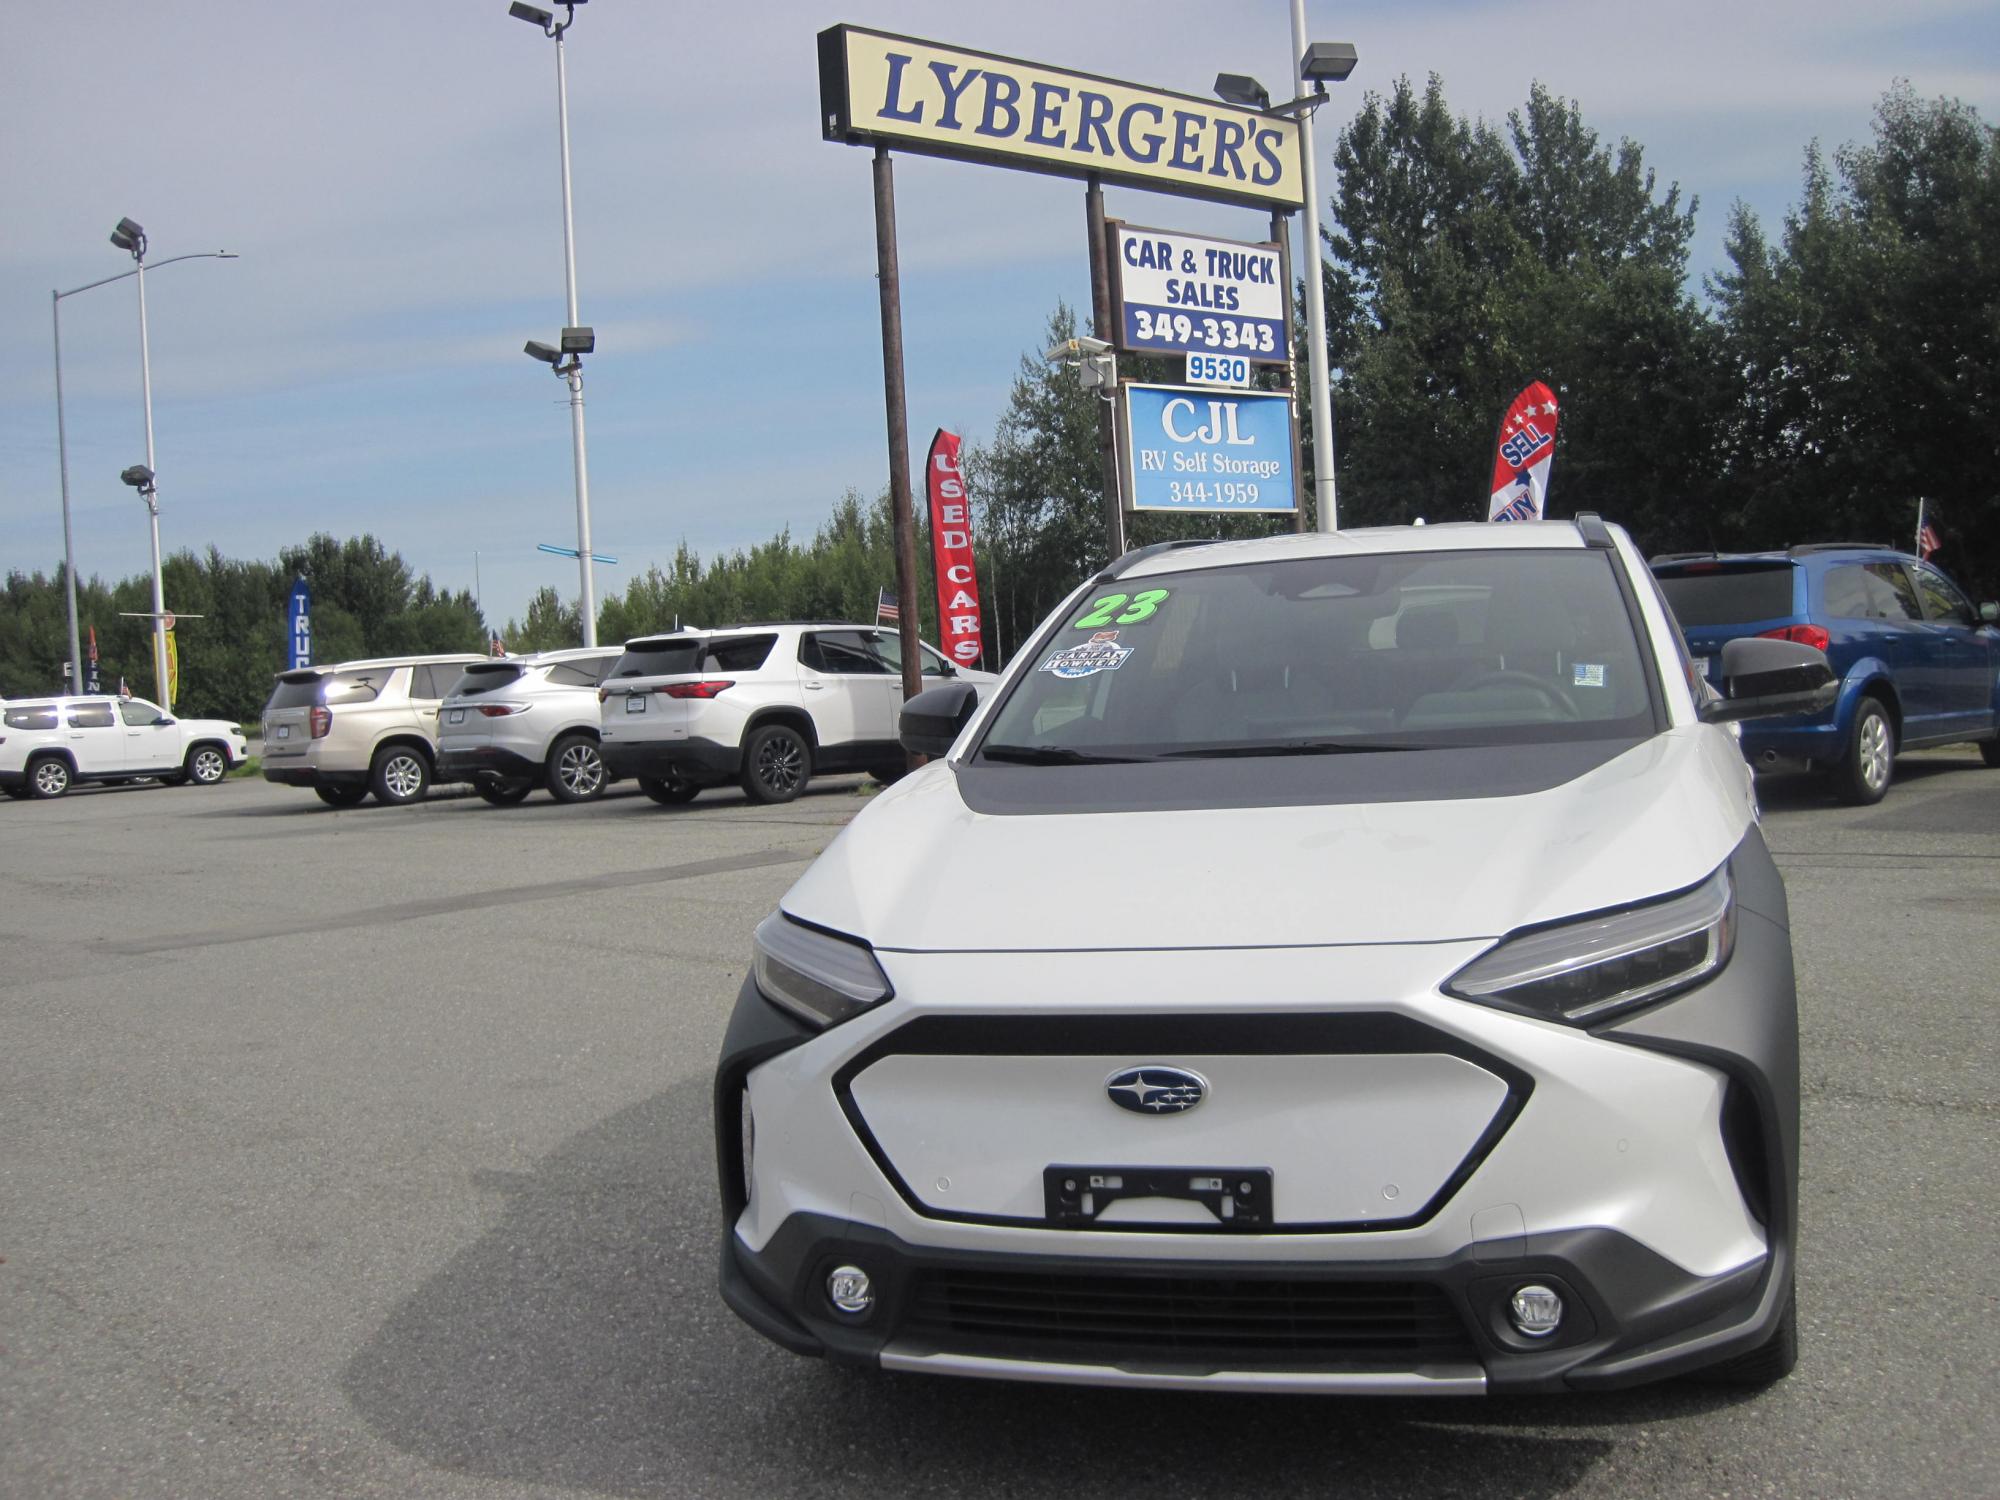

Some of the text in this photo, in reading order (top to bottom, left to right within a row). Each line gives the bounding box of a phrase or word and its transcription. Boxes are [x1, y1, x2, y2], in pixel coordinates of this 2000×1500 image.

[877, 52, 1284, 186] LYBERGER'S
[1124, 237, 1275, 284] CAR & TRUCK
[1166, 278, 1240, 311] SALES
[1134, 310, 1275, 352] 349-3343
[1190, 356, 1245, 382] 9530
[1161, 398, 1255, 445] CJL
[1140, 450, 1280, 479] RV Self Storage
[1500, 422, 1552, 468] SELL
[1170, 482, 1259, 504] 344-1959
[934, 454, 980, 660] USED CARS
[1074, 589, 1170, 629] 23
[1055, 650, 1127, 660] CARFAX
[1059, 659, 1118, 668] OWNER
